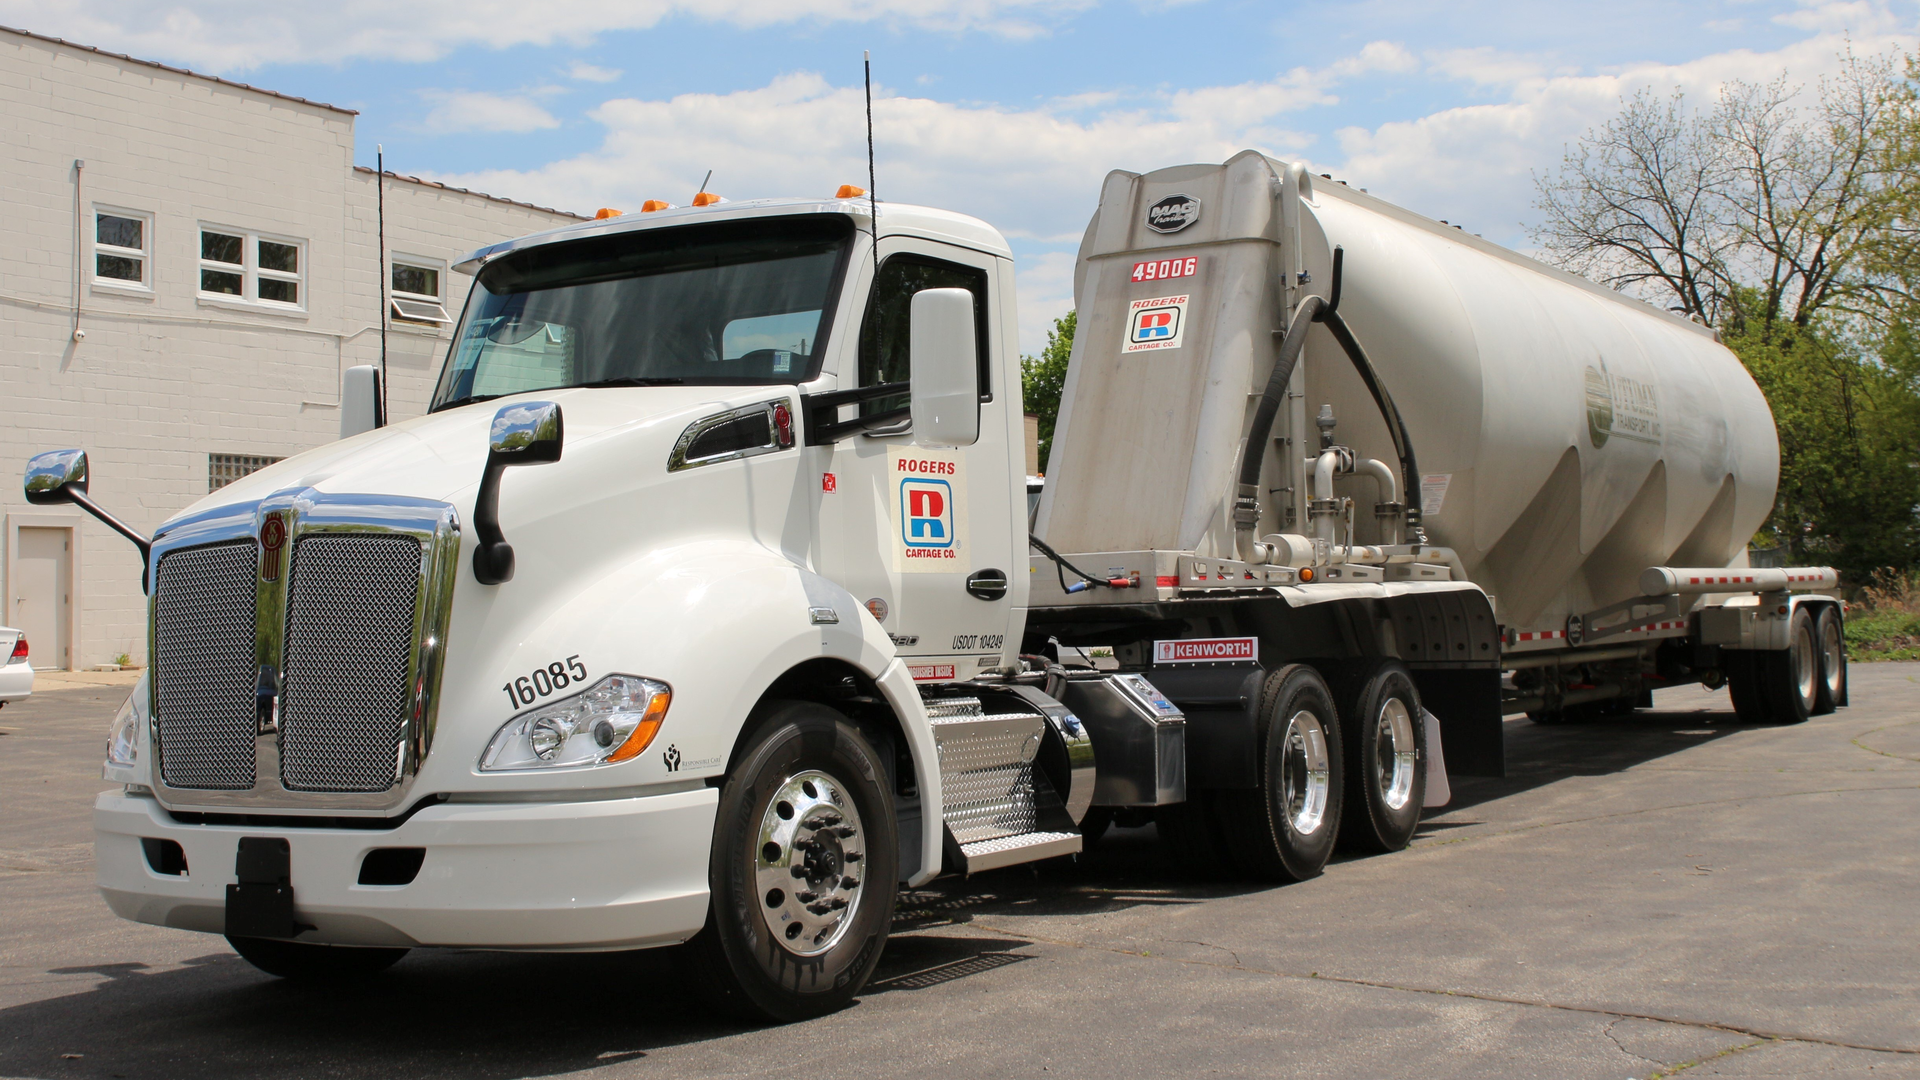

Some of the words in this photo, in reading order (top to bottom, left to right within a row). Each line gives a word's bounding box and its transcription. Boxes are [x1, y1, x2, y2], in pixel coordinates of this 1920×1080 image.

[1132, 258, 1196, 281] 49006
[1132, 296, 1187, 309] ROGERS
[1128, 343, 1160, 351] CARTAGE
[897, 459, 955, 475] ROGERS
[906, 549, 942, 558] CARTAGE
[944, 549, 956, 559] CO.
[952, 635, 978, 650] USDOT
[979, 634, 1003, 649] 104249
[1176, 642, 1251, 657] KENWORTH
[935, 665, 953, 677] INSIDE
[503, 654, 587, 710] 16085
